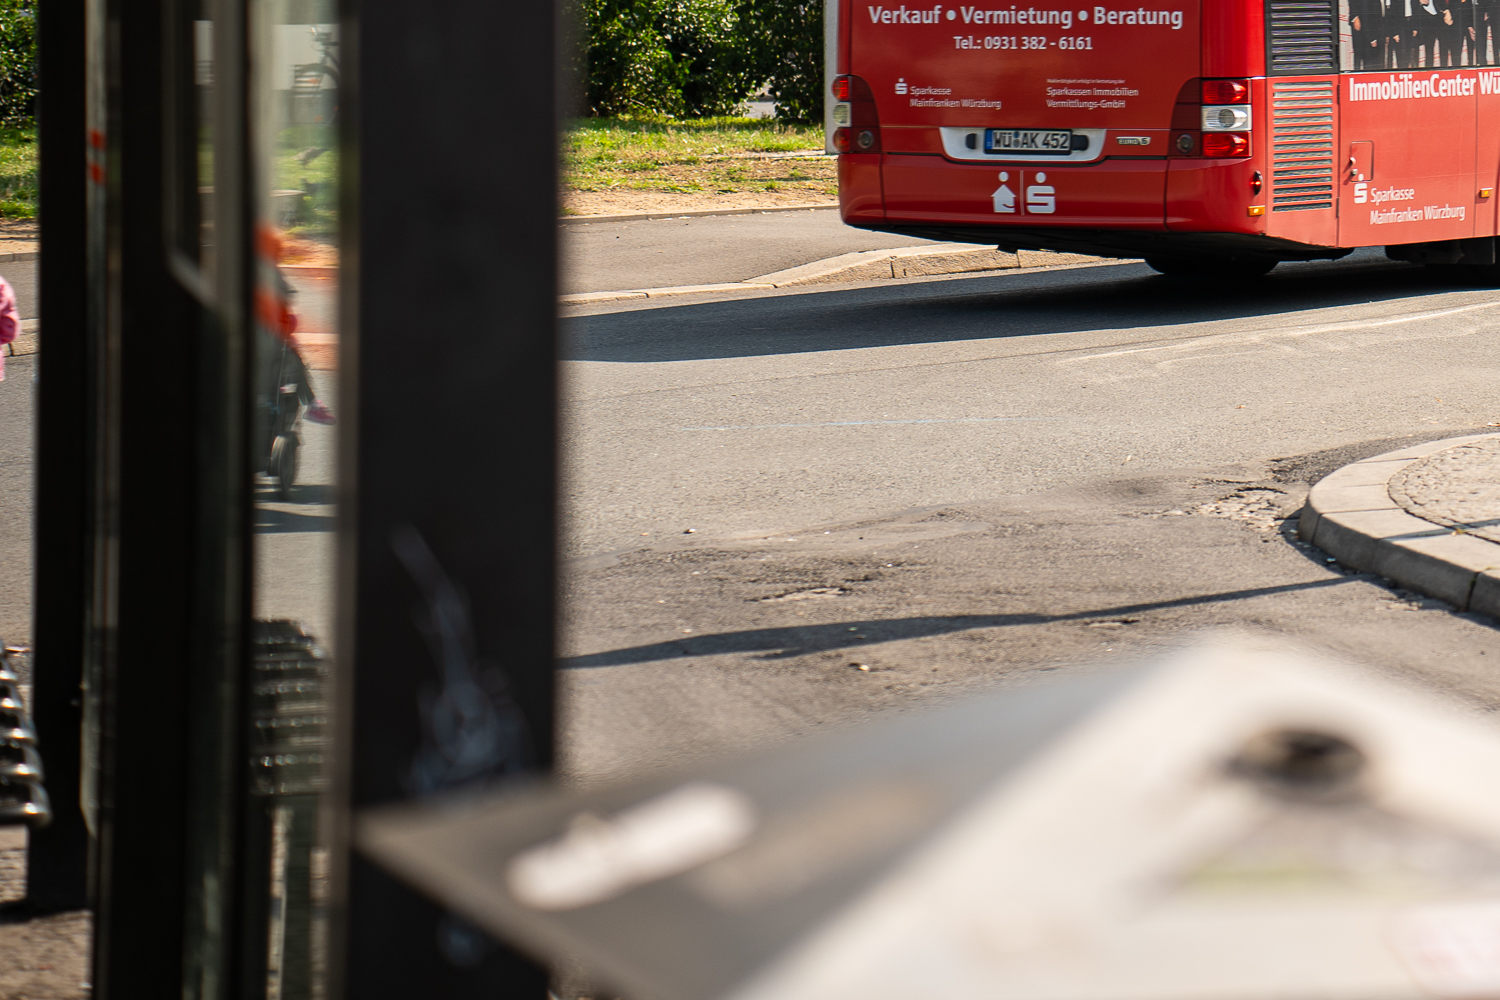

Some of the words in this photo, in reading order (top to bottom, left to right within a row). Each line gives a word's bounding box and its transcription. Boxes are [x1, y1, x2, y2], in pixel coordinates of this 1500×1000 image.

[868, 4, 941, 25] Verkauf
[961, 5, 1073, 30] Vermietung
[1093, 6, 1183, 30] Beratung
[953, 36, 982, 50] Tel.:
[984, 36, 1018, 50] 0931
[1021, 37, 1047, 50] 382
[1058, 37, 1093, 51] 6161
[909, 86, 952, 97] Sparkasse
[1046, 86, 1092, 97] Sparkassen
[1093, 87, 1139, 97] Immobilien
[1349, 73, 1476, 102] ImmobilienCenter
[909, 98, 961, 108] Mainfranken
[961, 98, 1002, 110] Würzburg
[1046, 98, 1126, 110] Vermittlungs-GmbH
[993, 132, 1012, 149] WÜ
[1020, 133, 1040, 149] AK
[1042, 132, 1069, 149] 452
[1370, 186, 1415, 206] Sparkasse
[1370, 206, 1423, 225] Mainfranken
[1423, 203, 1466, 222] Würzburg
